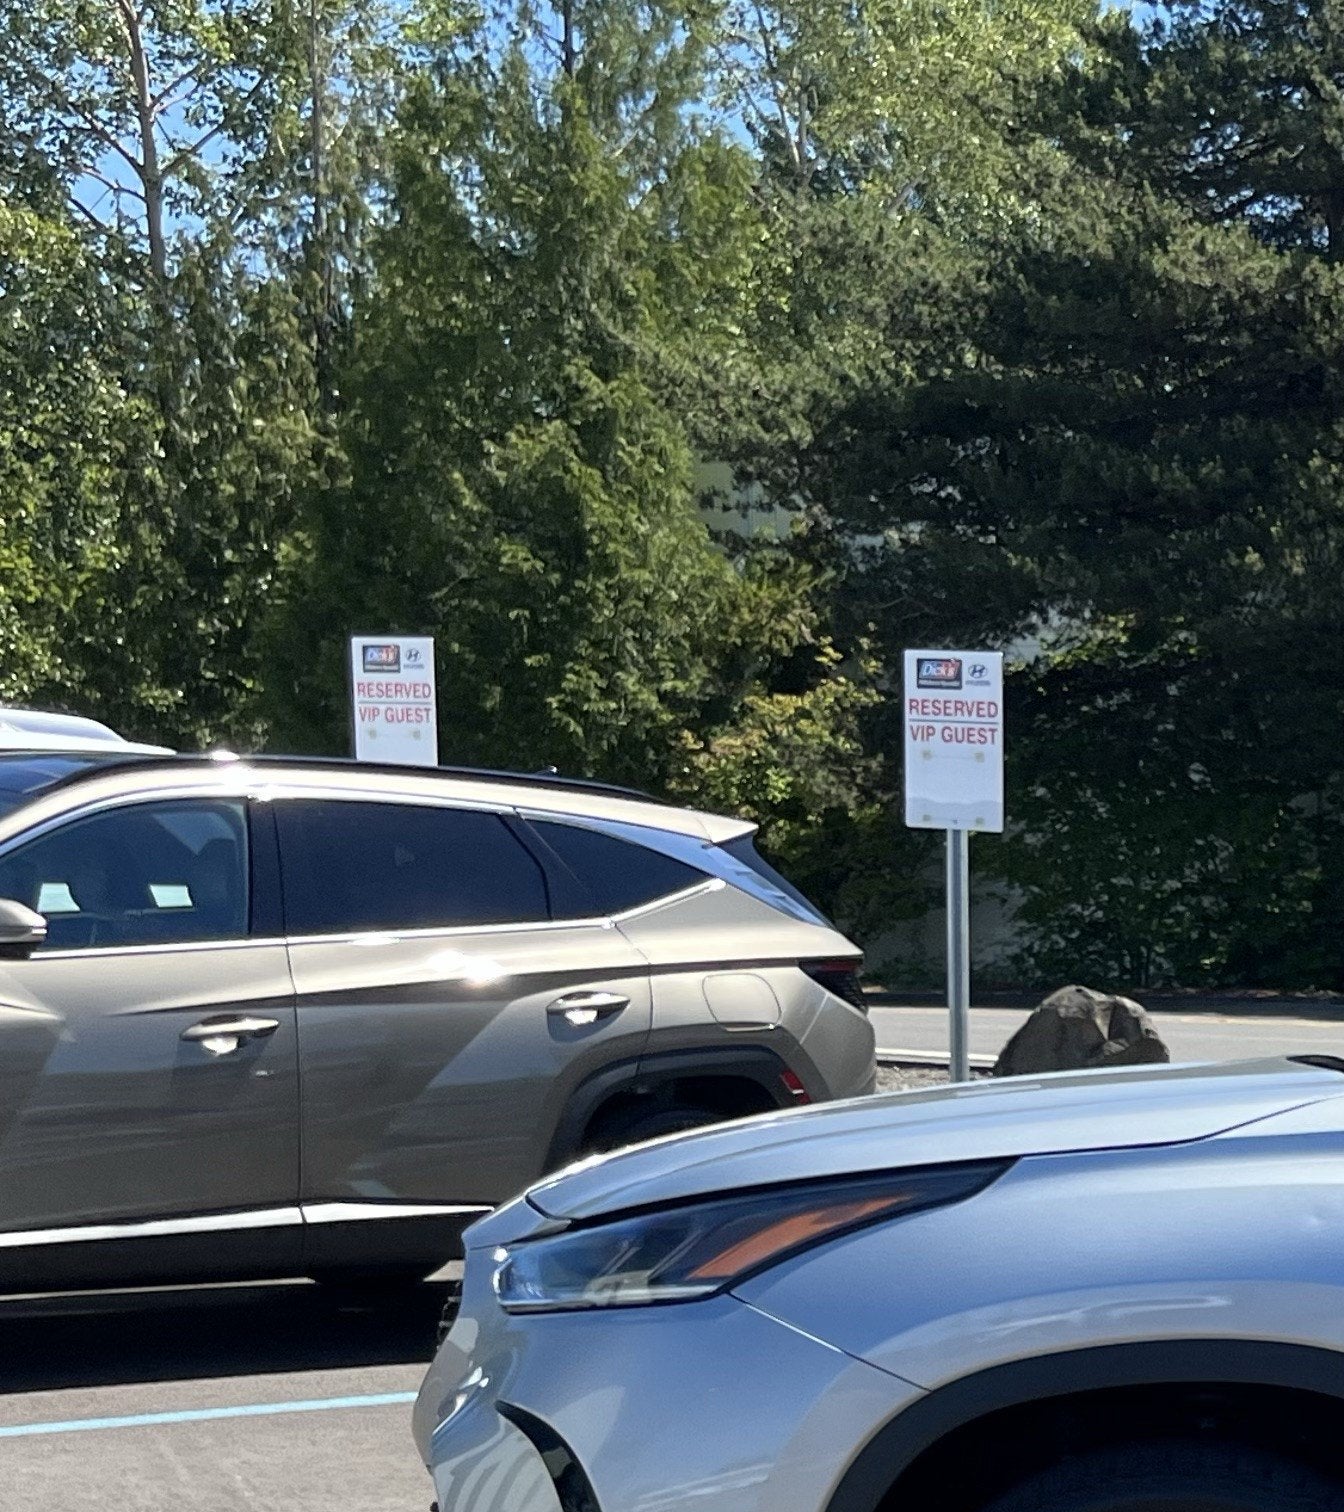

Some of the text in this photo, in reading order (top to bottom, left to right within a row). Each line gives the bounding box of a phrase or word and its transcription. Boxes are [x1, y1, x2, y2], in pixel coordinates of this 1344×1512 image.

[357, 682, 432, 699] RESERVED
[359, 706, 432, 723] VIP GUEST
[909, 699, 998, 718] RESERVED
[910, 725, 998, 745] VIP GUEST
